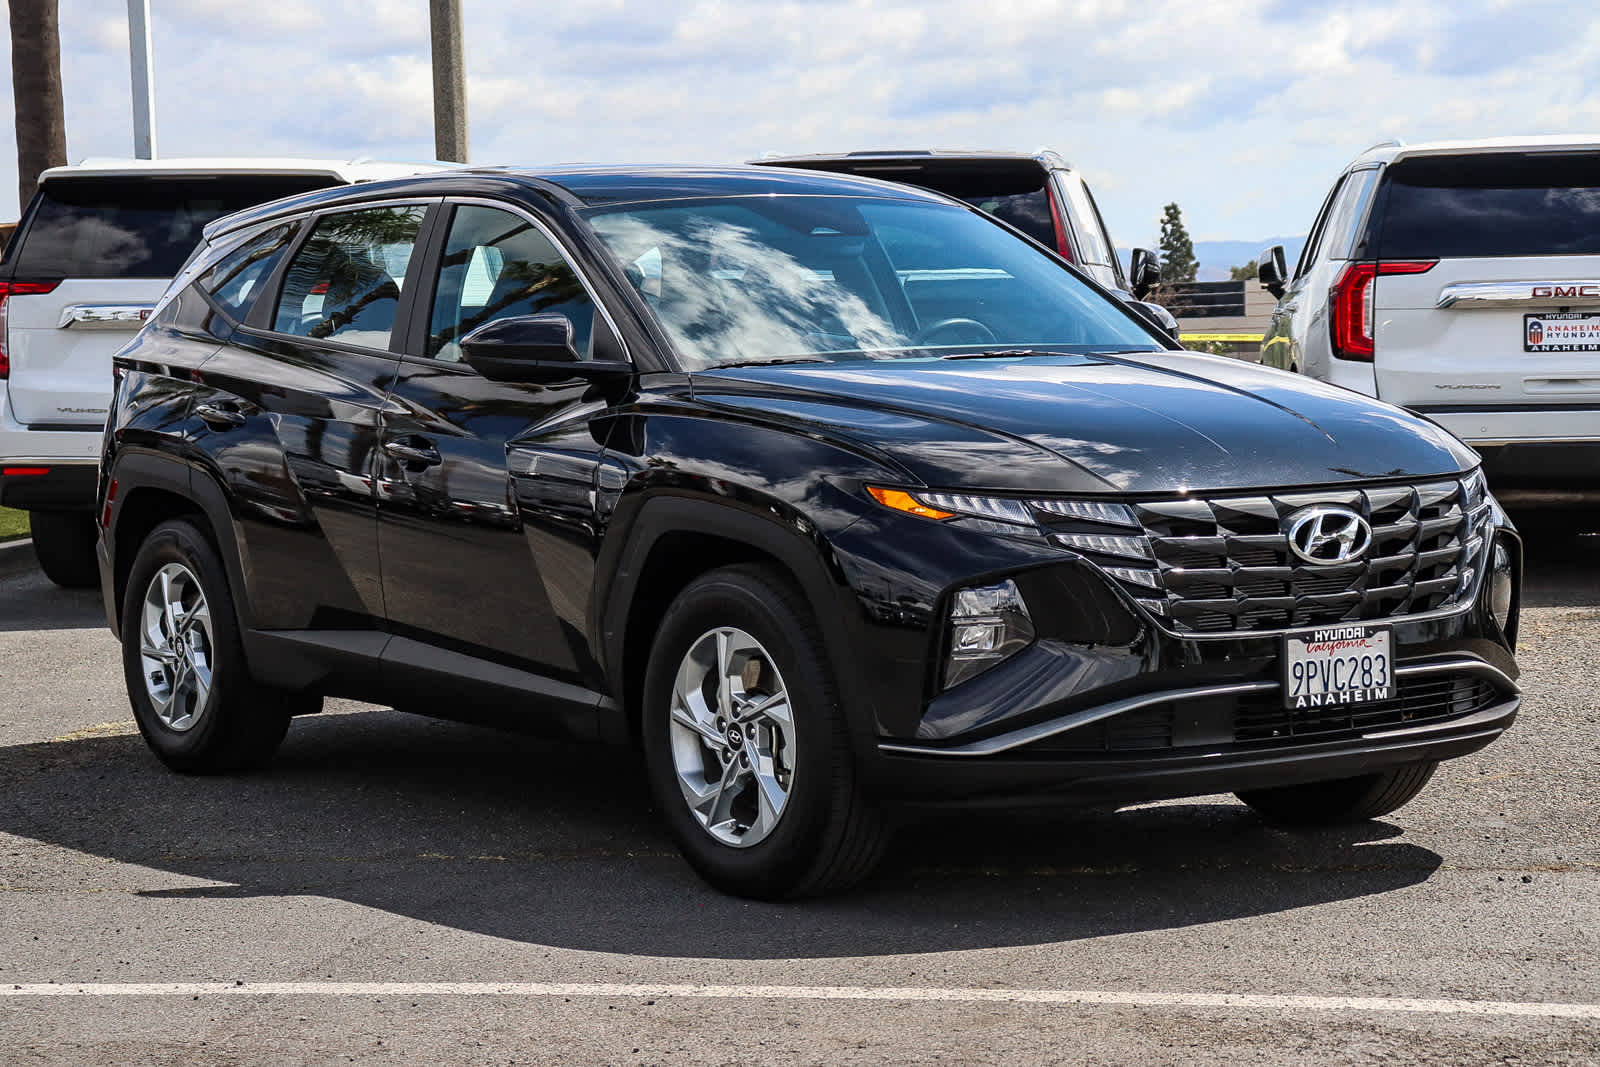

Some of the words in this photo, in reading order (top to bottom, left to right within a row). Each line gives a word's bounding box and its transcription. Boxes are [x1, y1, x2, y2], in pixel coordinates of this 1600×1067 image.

[1532, 286, 1600, 297] GMC
[1315, 627, 1365, 641] HYUNDAI
[1292, 654, 1387, 696] 9PVC283
[1296, 688, 1388, 709] ANAHEIM
